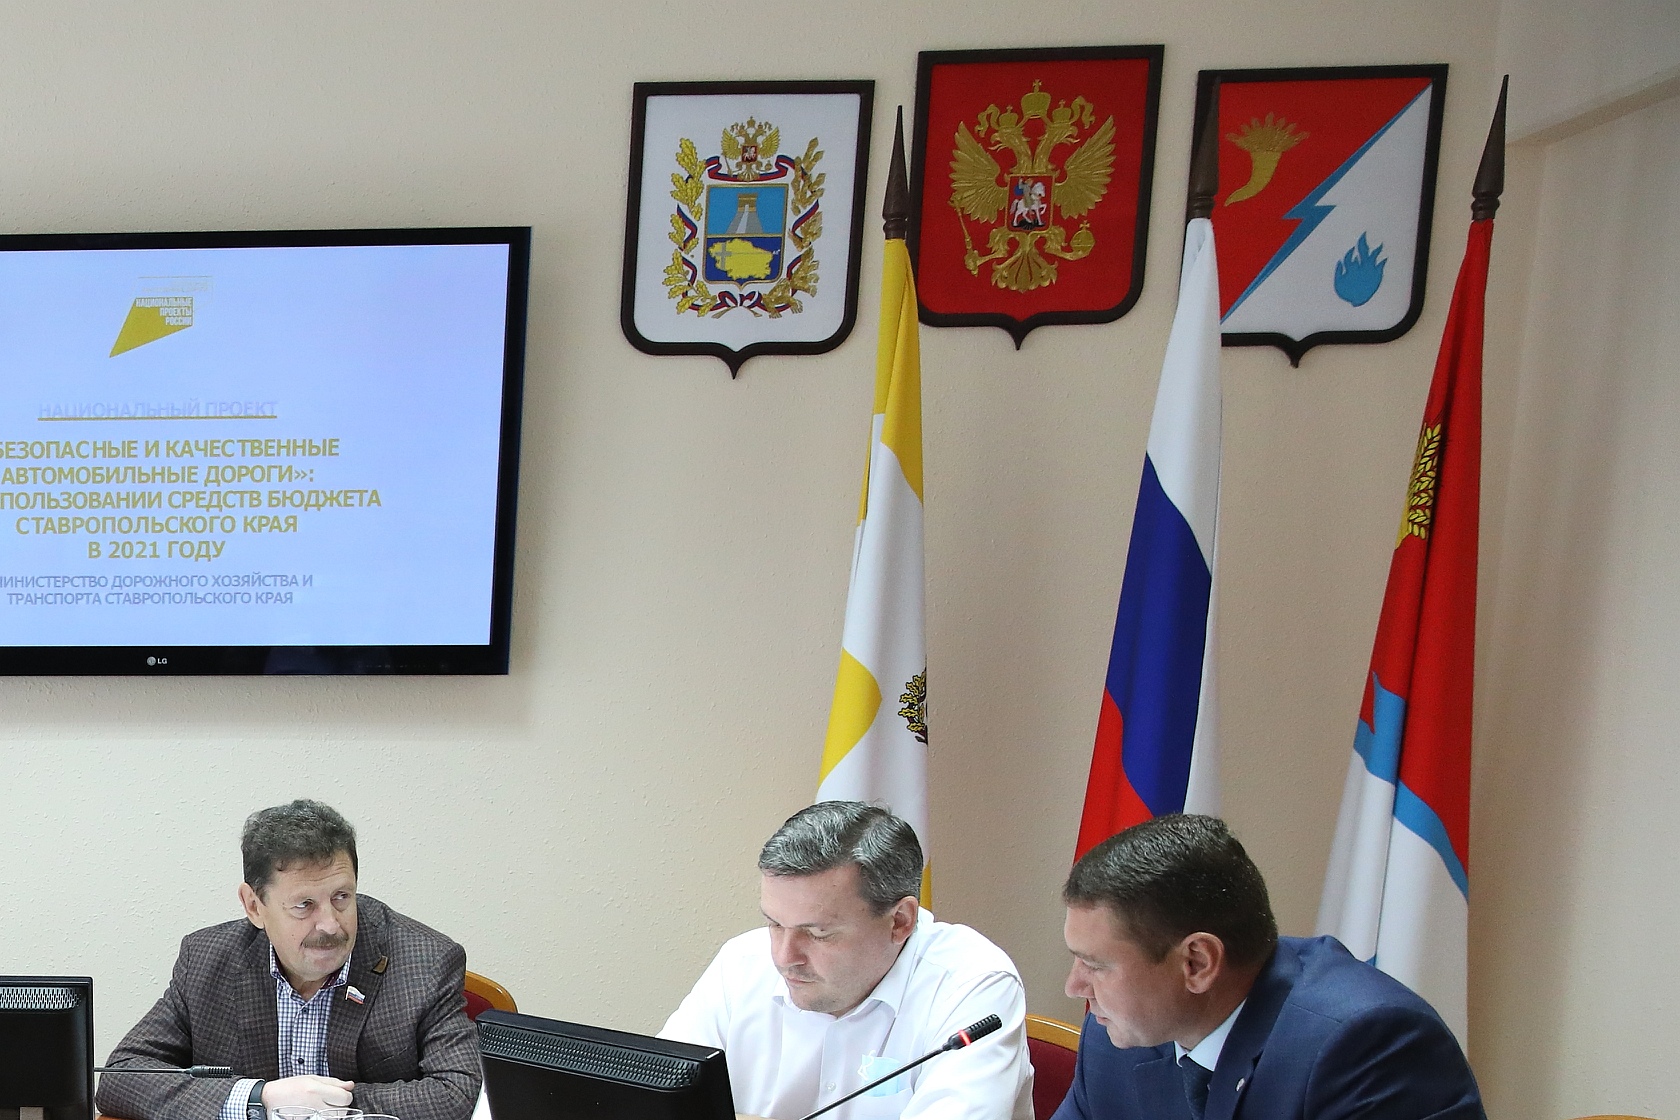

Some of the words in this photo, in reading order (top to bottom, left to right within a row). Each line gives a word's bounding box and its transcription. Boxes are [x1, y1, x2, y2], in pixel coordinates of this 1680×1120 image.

[135, 298, 191, 308] НАЦИОНАЛЬНЫЕ
[159, 307, 191, 317] ПРОЕКТЫ
[165, 316, 191, 326] РОССИИ
[39, 398, 200, 418] НАЦИОНАЛЬНЫЙ
[205, 400, 277, 416] ПРОЕКТ
[144, 440, 160, 458] И
[165, 438, 340, 458] КАЧЕСТВЕННЫЕ
[1, 465, 199, 485] АВТОМОБИЛЬНЫЕ
[204, 465, 314, 487] ДОРОГИ»:
[167, 490, 263, 512] СРЕДСТВ
[267, 489, 382, 512] БЮДЖЕТА
[15, 515, 236, 535] СТАВРОПОЛЬСКОГО
[242, 515, 298, 533] КРАЯ
[88, 541, 102, 559] В
[108, 541, 160, 559] 2021
[167, 541, 226, 562] ГОДУ
[111, 574, 208, 590] ДОРОЖНОГО
[211, 571, 299, 587] ХОЗЯЙСТВА
[303, 574, 313, 587] И
[7, 592, 102, 605] ТРАНСПОРТА
[105, 592, 252, 605] СТАВРОПОЛЬСКОГО
[255, 591, 294, 604] КРАЯ
[157, 657, 168, 665] LG
